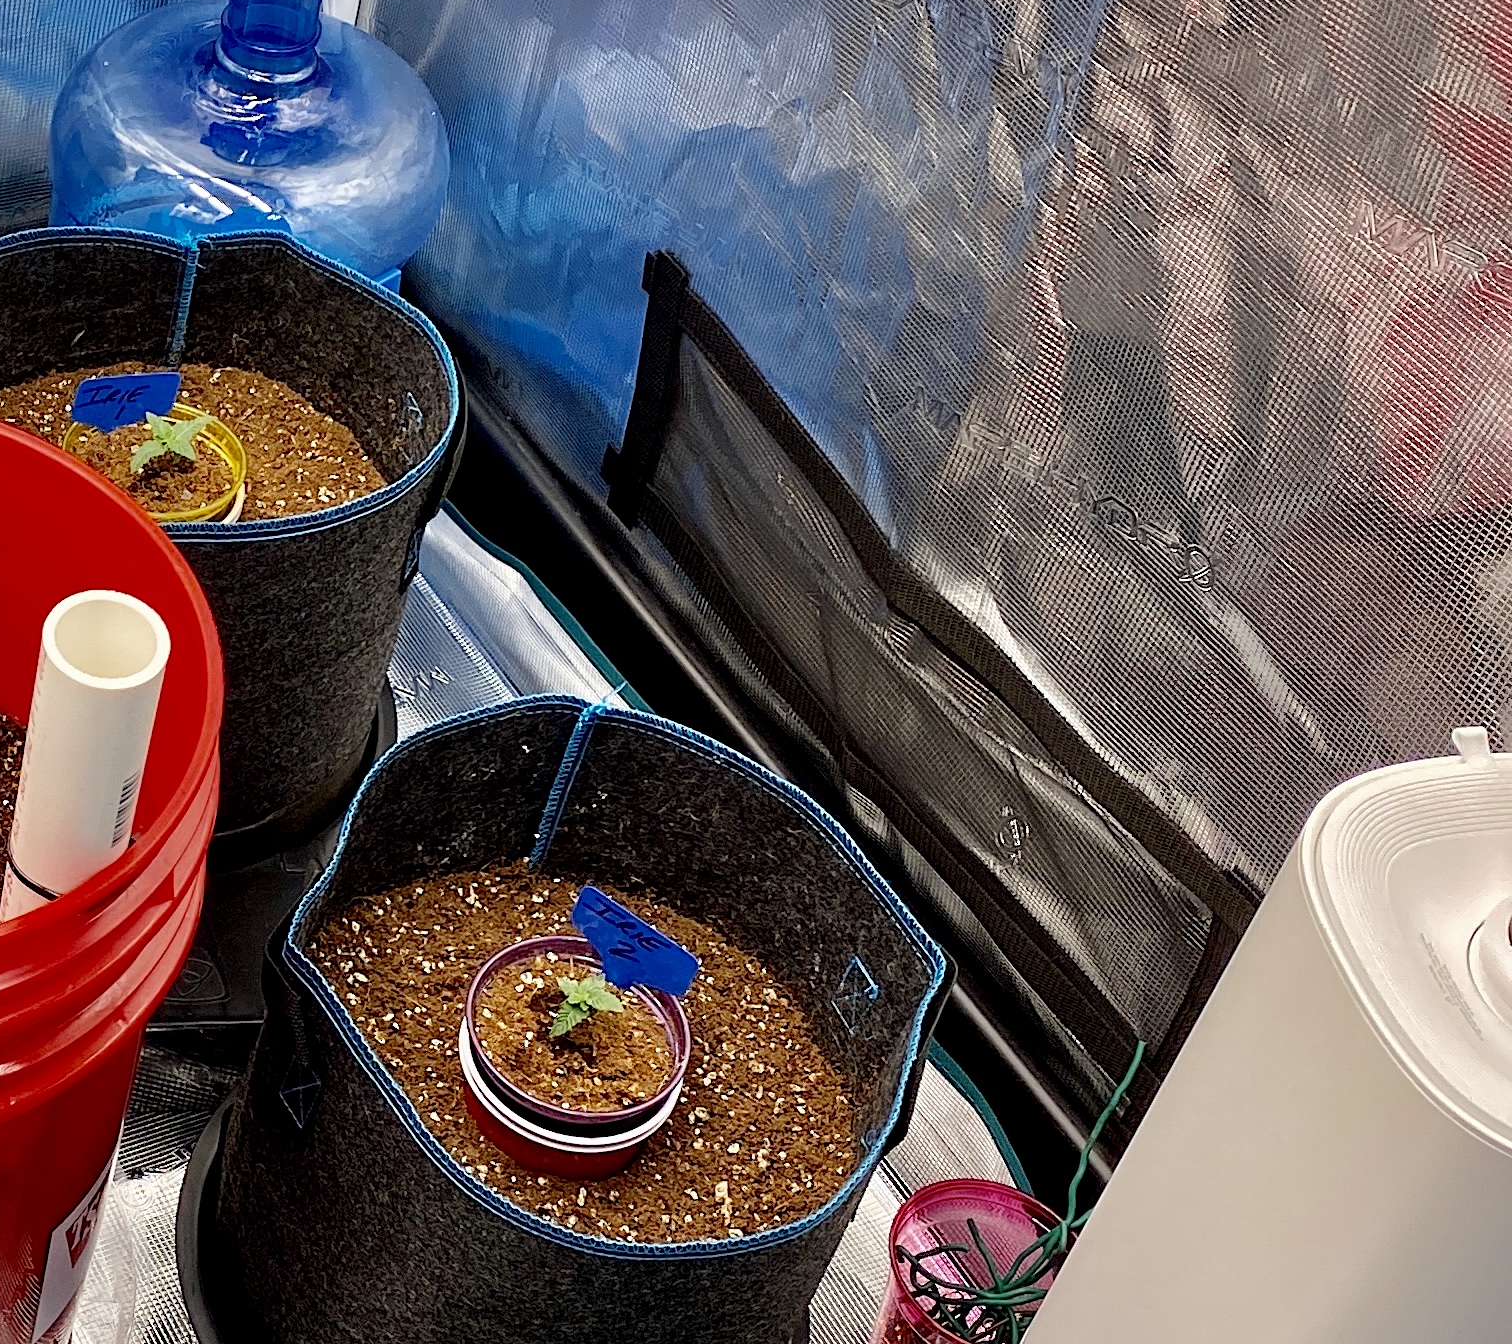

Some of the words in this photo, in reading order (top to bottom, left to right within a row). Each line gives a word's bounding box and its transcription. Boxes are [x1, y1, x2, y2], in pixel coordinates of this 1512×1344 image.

[76, 384, 151, 409] IRIE
[581, 896, 672, 953] IRIE
[607, 939, 640, 964] 2
